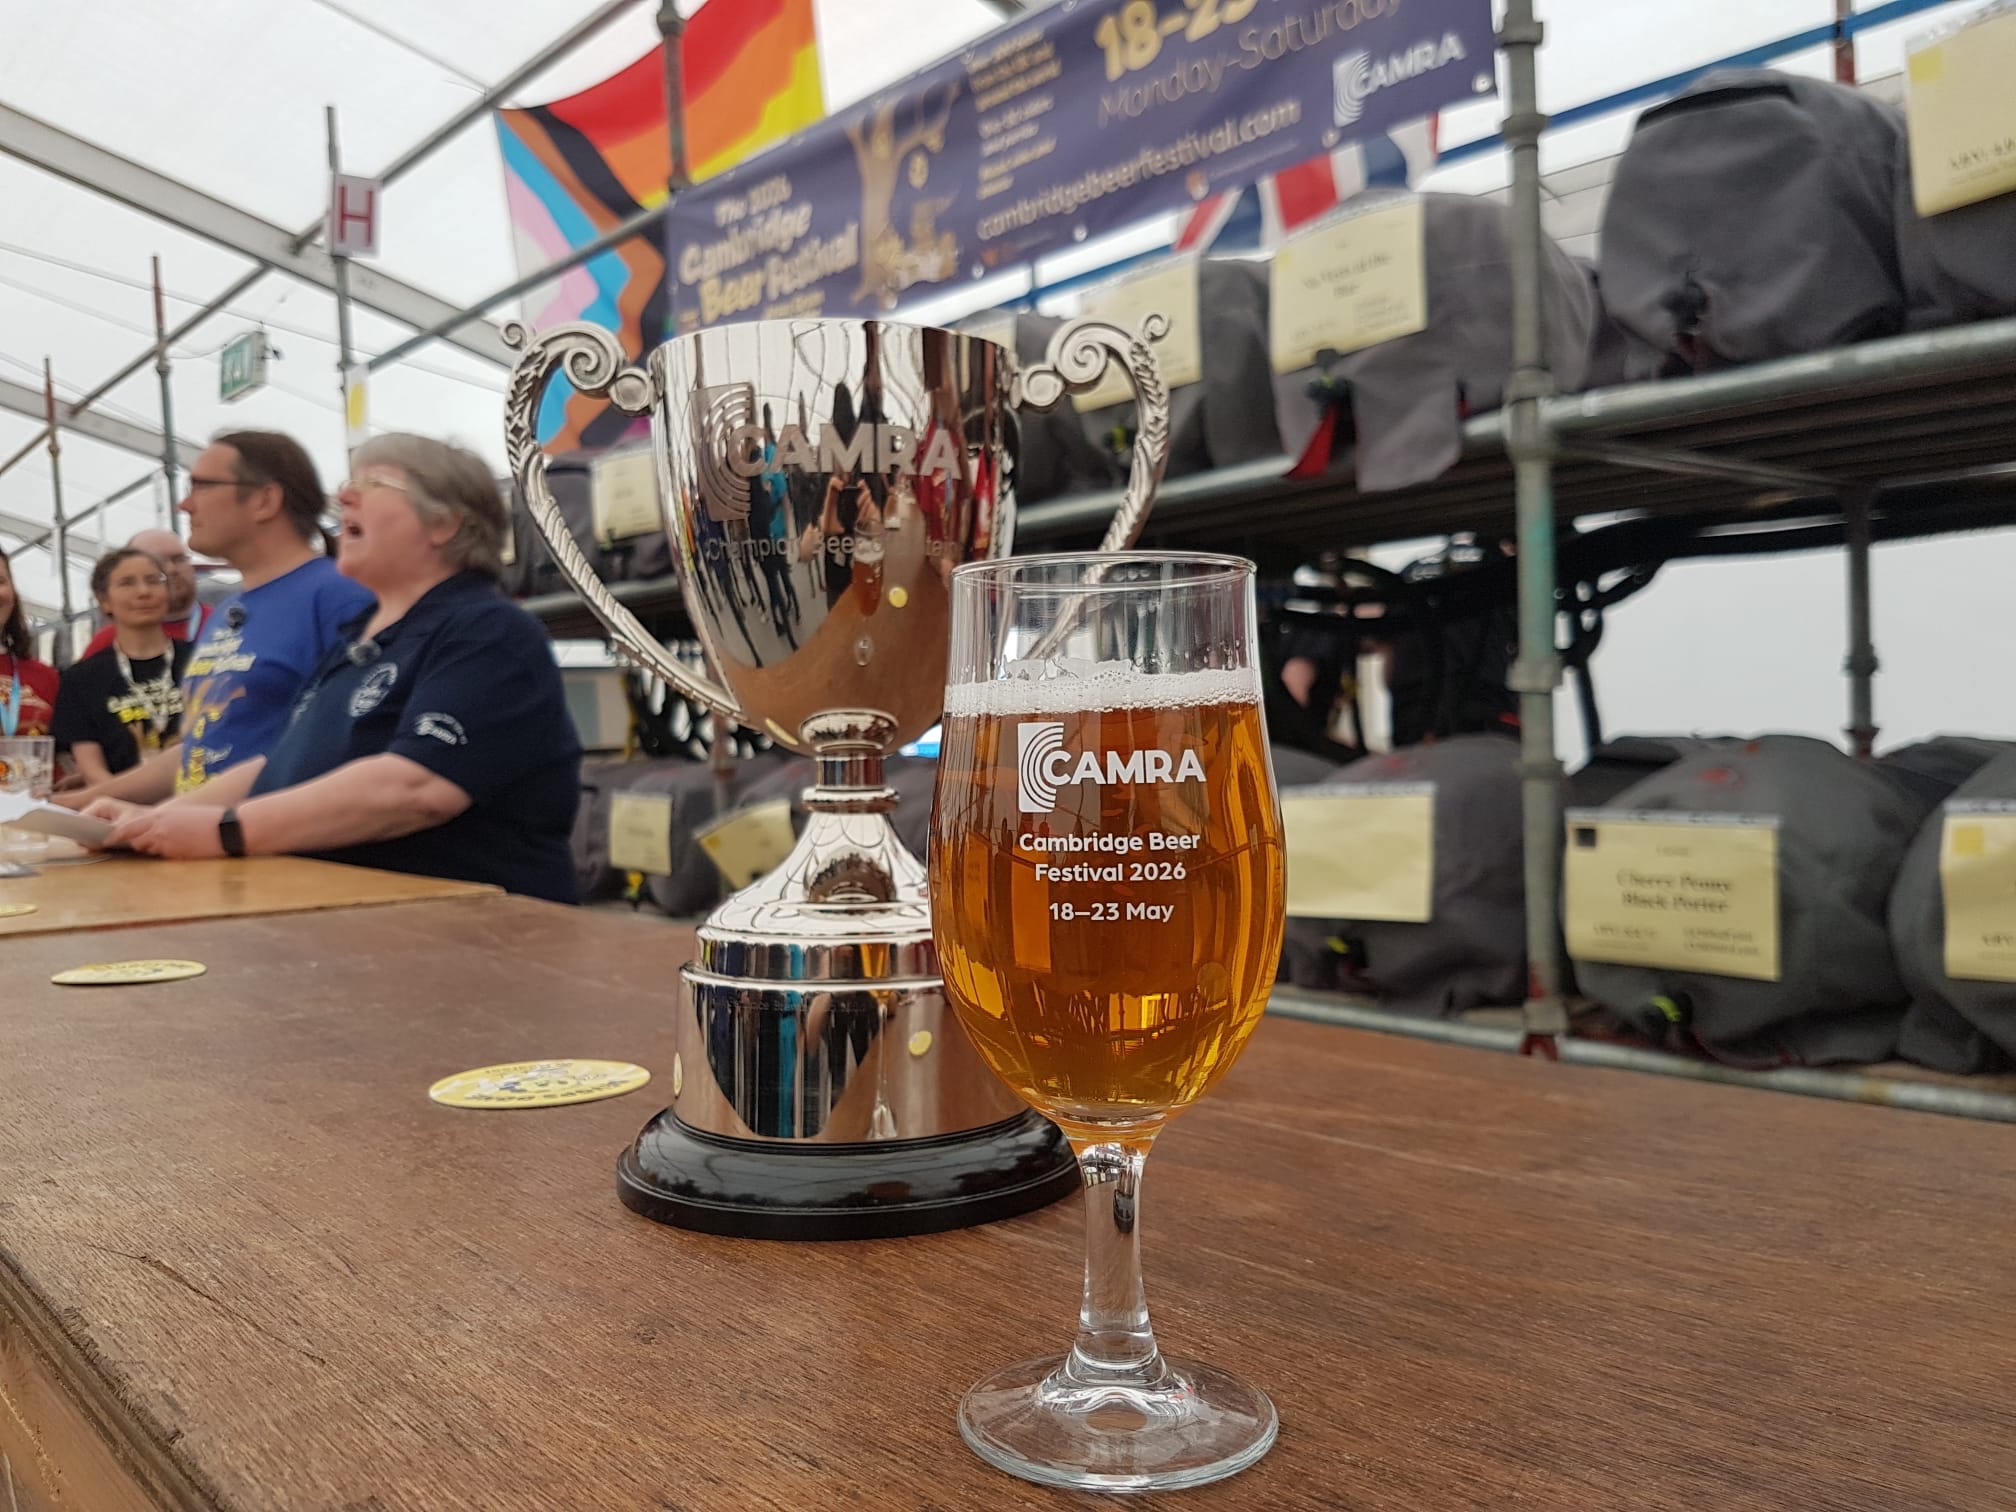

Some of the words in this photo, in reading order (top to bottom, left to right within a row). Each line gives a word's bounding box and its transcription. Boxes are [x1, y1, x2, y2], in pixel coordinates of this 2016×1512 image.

[1356, 32, 1468, 98] CAMRA
[977, 100, 1301, 240] cambridgebeerfestival.com
[338, 185, 377, 248] H
[679, 202, 814, 286] Cambridge
[699, 268, 767, 325] Beer
[766, 221, 859, 301] Festival
[728, 422, 963, 480] CAMRA
[1042, 749, 1207, 786] CAMRA
[1019, 832, 1143, 855] Cambridge
[1149, 832, 1201, 850] Beer
[1035, 862, 1123, 882] Festival
[1129, 862, 1187, 881] 2026
[1049, 902, 1120, 920] 18–23
[1126, 902, 1174, 922] May
